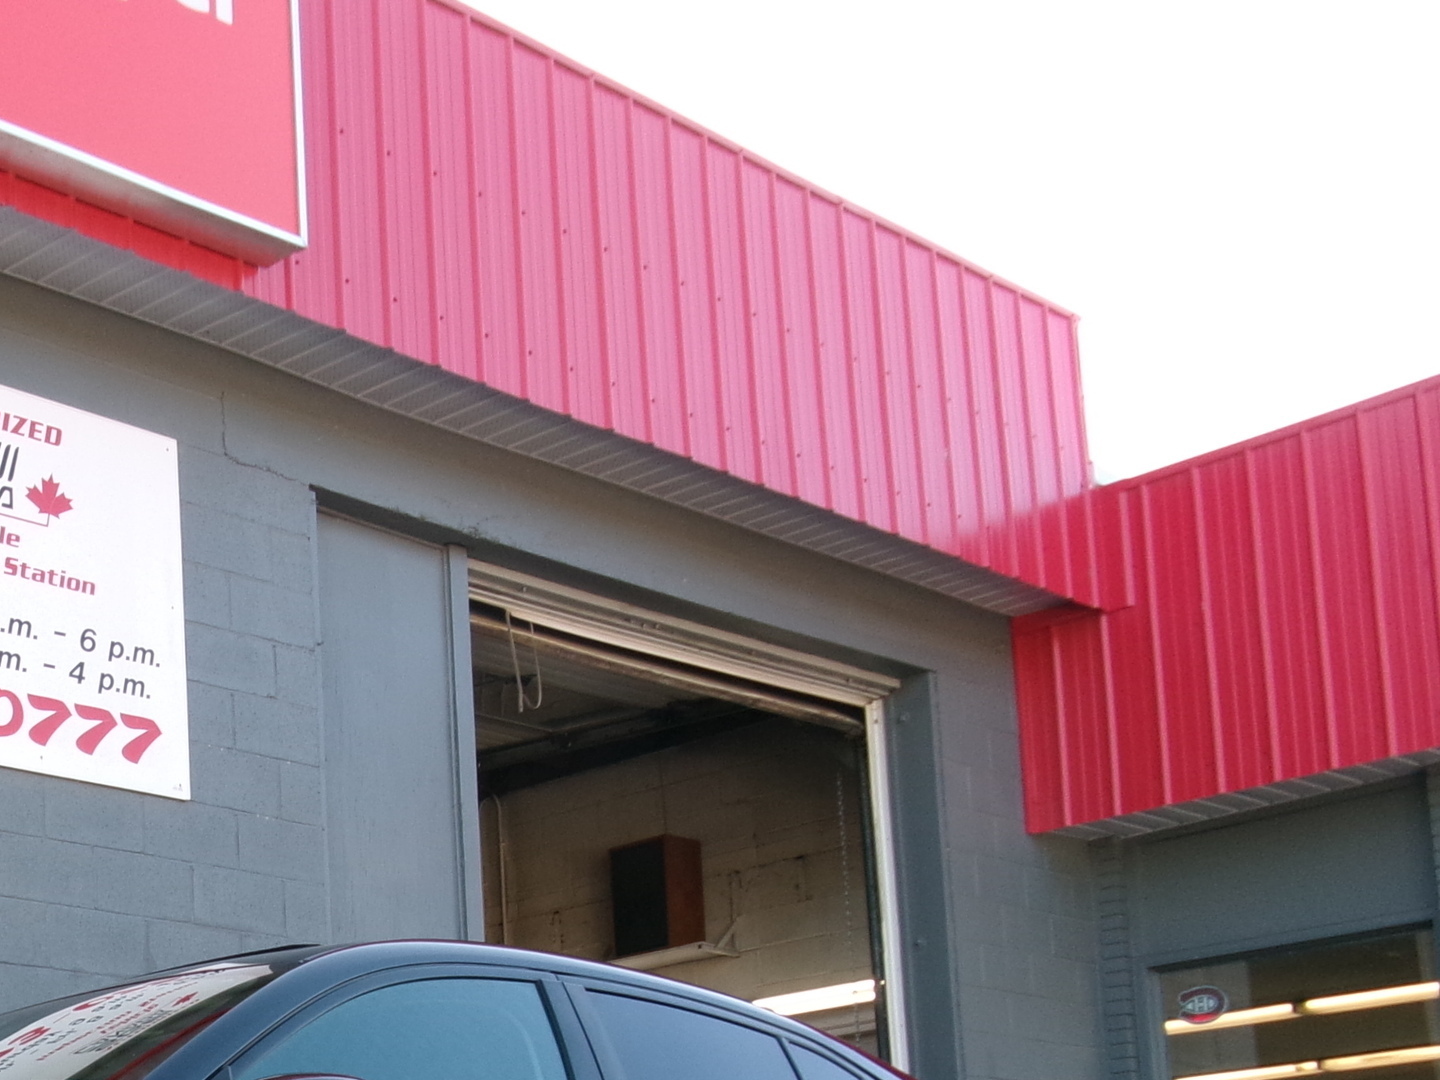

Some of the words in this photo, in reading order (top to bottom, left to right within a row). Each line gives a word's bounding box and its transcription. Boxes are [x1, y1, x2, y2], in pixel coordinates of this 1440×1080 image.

[3, 557, 97, 596] Station
[79, 628, 97, 653] 6
[108, 640, 160, 668] p.m.
[68, 661, 86, 684] 4
[98, 672, 151, 699] p.m.
